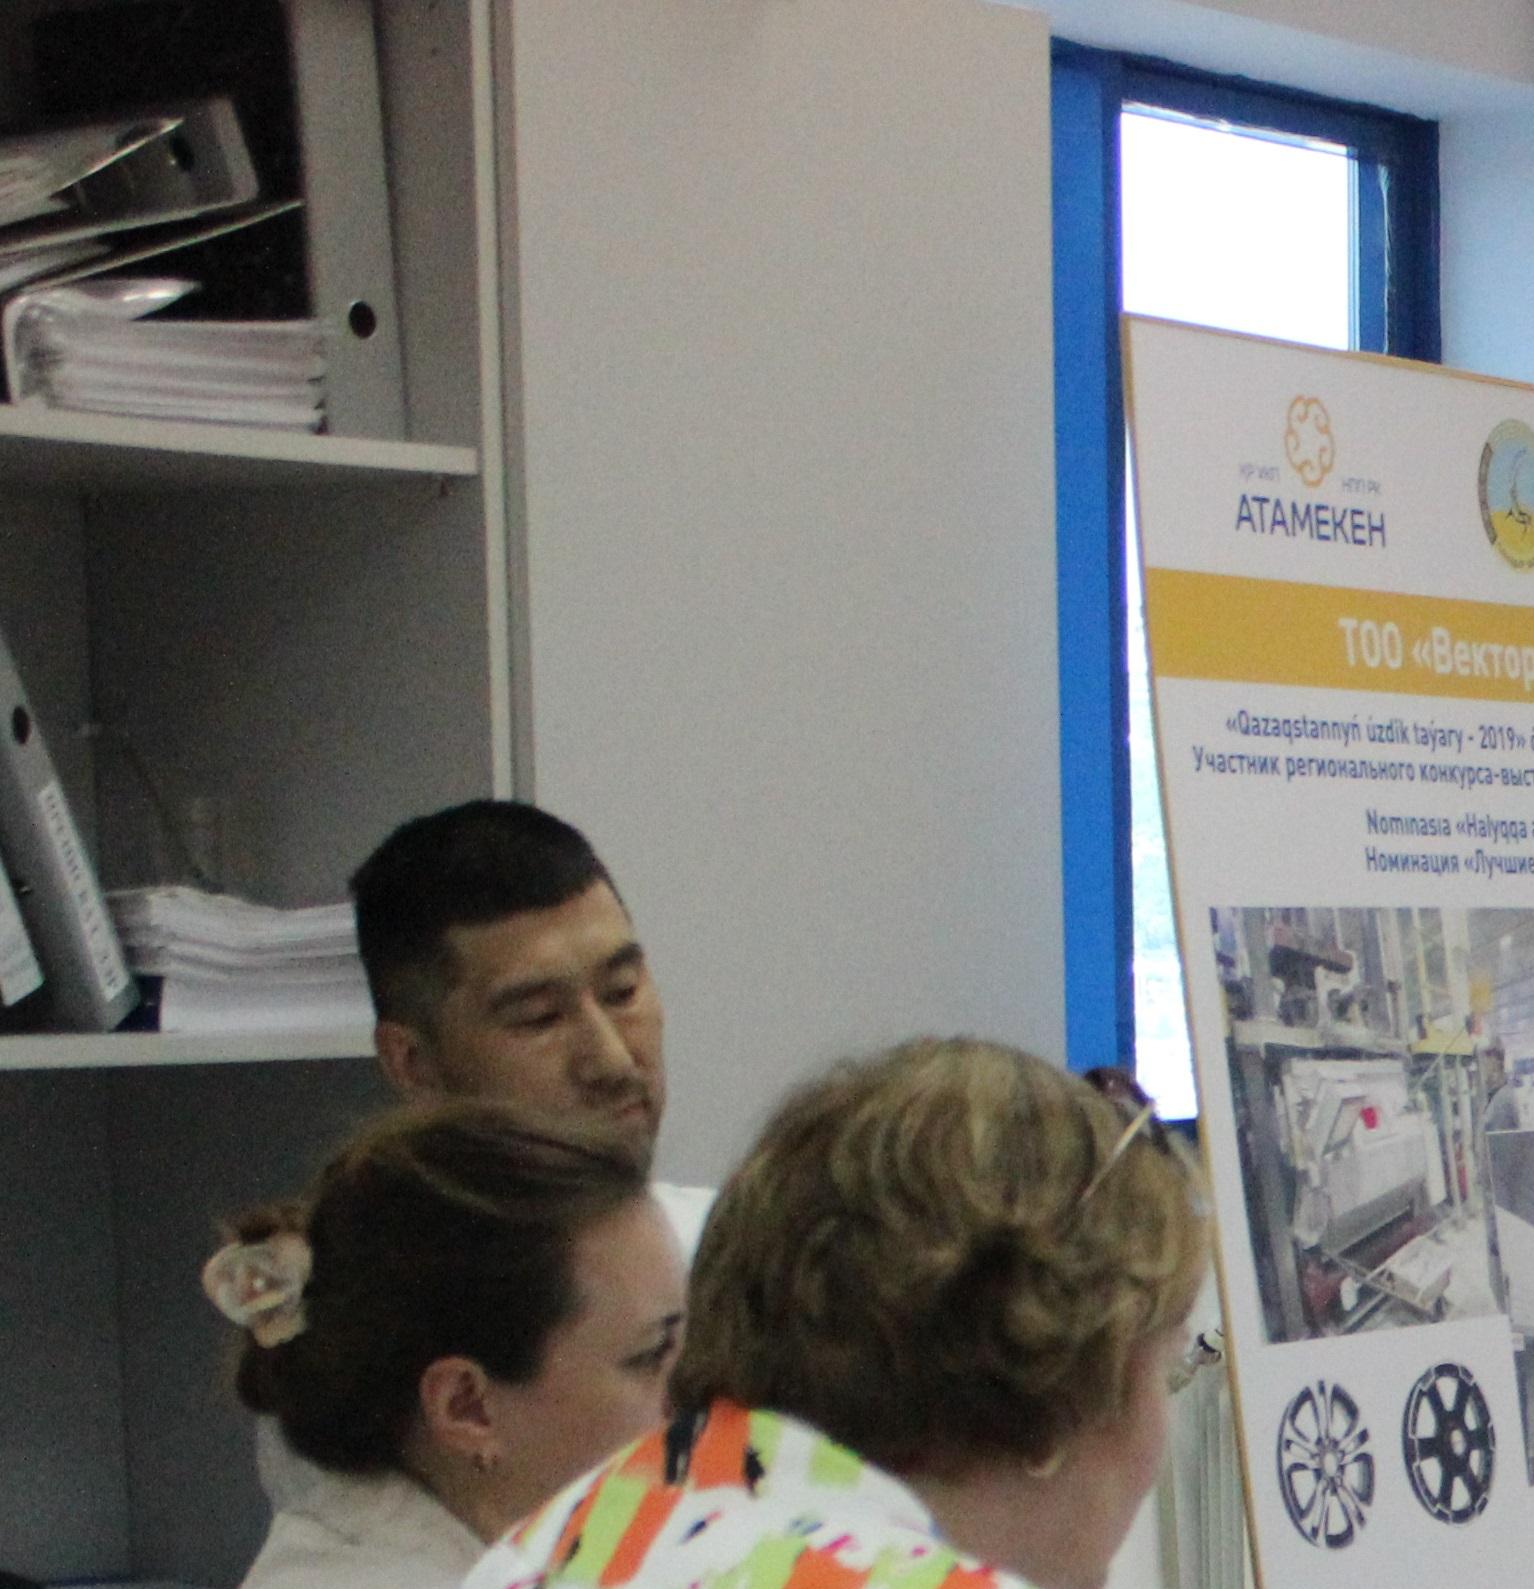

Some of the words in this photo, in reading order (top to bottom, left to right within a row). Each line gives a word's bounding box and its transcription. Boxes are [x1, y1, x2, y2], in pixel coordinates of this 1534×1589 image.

[1235, 493, 1387, 548] АТАМЕКЕН
[1338, 617, 1403, 670] ТОО
[1478, 724, 1525, 751] 2019»
[1192, 745, 1281, 775] Участник
[1285, 756, 1415, 783] регионального
[1365, 846, 1460, 876] Номинация
